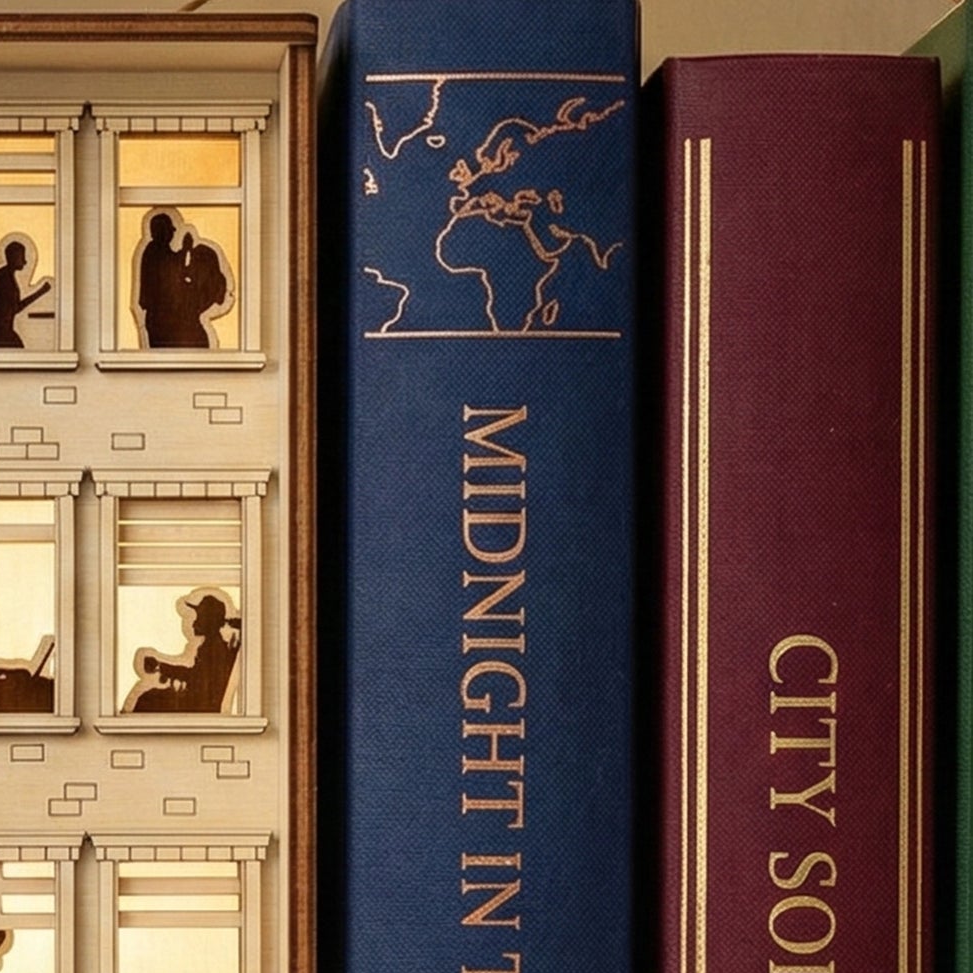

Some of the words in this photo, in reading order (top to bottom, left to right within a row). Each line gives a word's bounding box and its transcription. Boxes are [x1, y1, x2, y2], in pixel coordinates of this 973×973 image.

[460, 405, 528, 830] MIDNIGHT
[767, 632, 840, 826] CITY
[459, 852, 523, 930] IN
